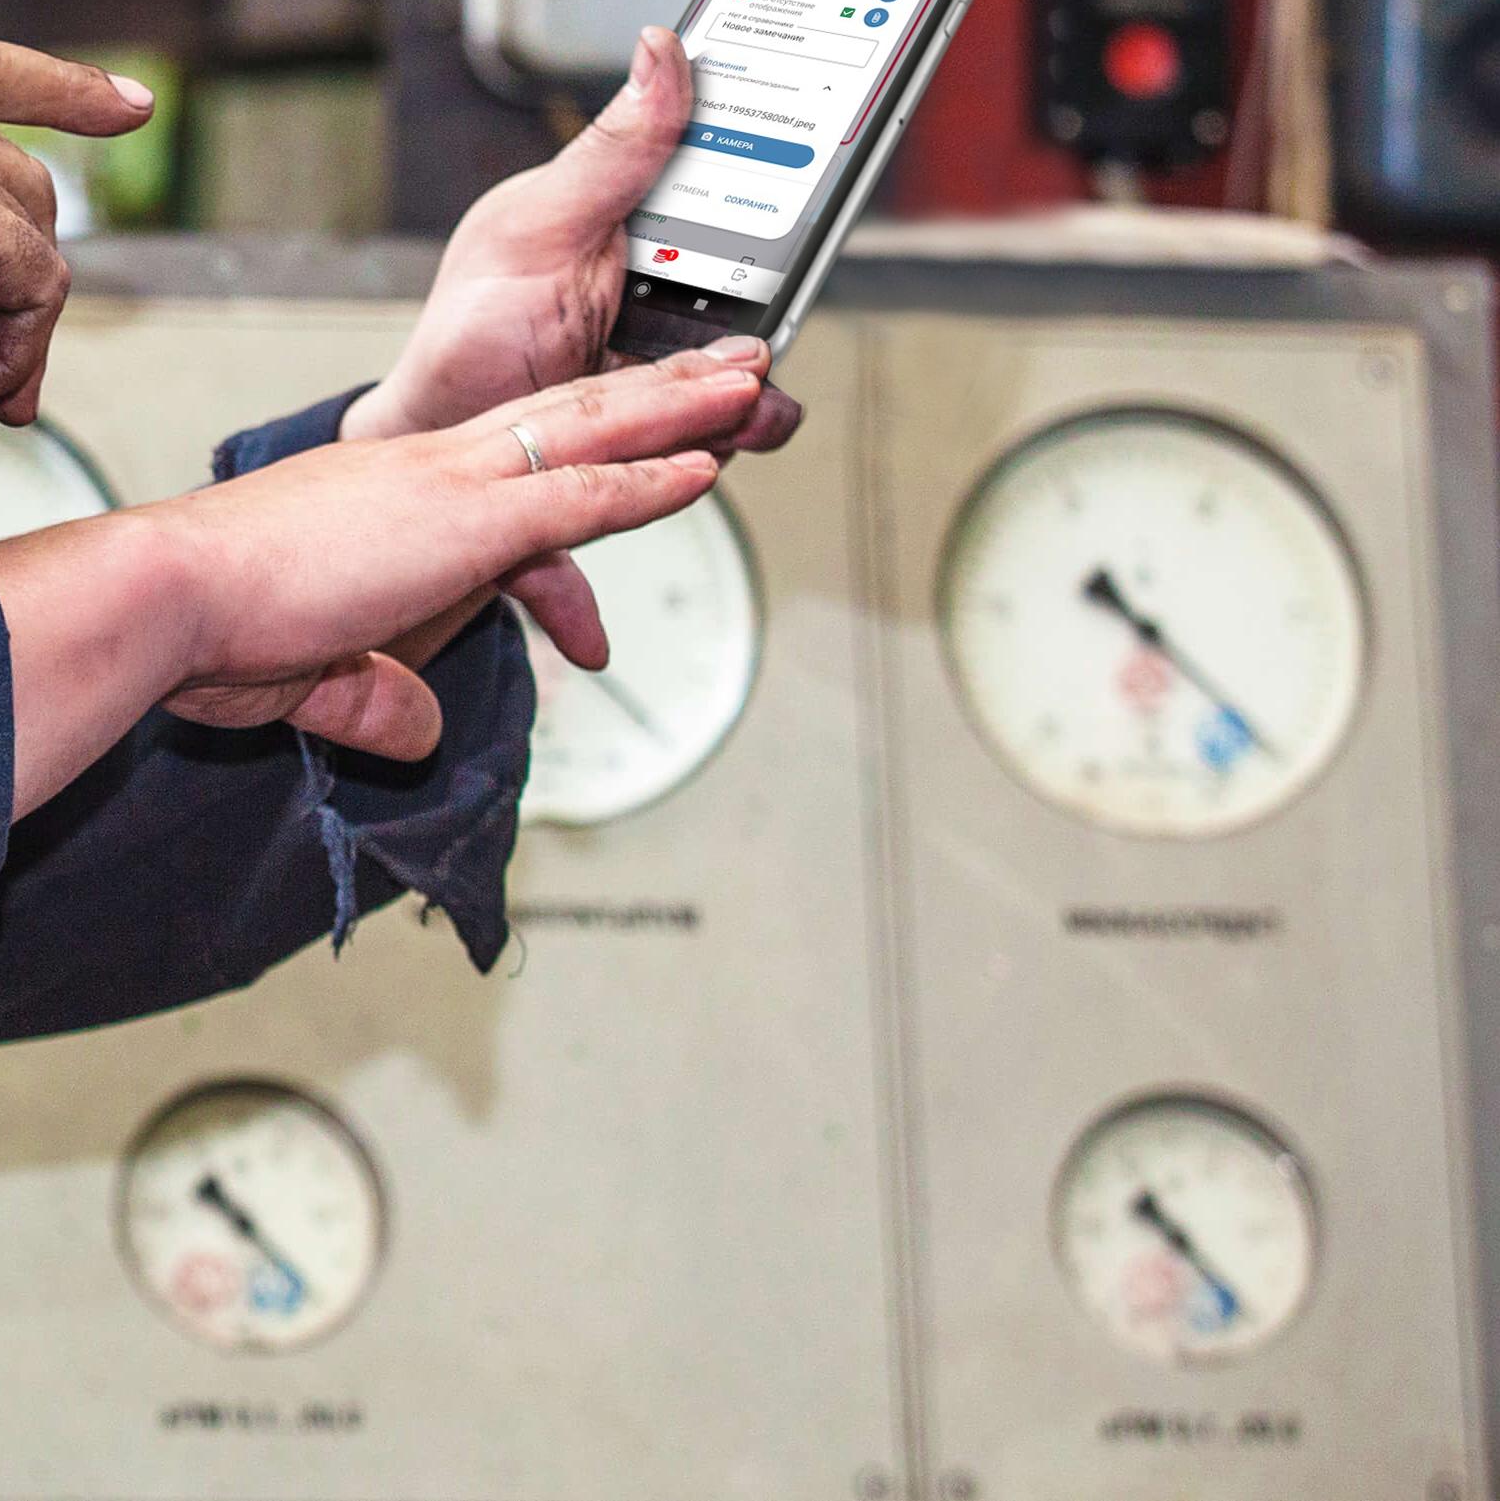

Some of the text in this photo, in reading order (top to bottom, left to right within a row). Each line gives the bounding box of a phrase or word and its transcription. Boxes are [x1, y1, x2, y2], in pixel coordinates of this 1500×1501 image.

[749, 1, 803, 17] отображения
[728, 11, 741, 20] Нет
[748, 15, 795, 29] справочнике
[722, 20, 805, 43] Новое замечание
[700, 56, 748, 72] Вложения
[716, 136, 754, 151] КАМЕРА
[672, 183, 779, 214] ОТМЕНА СОХРАНИТЬ
[669, 251, 675, 259] 1
